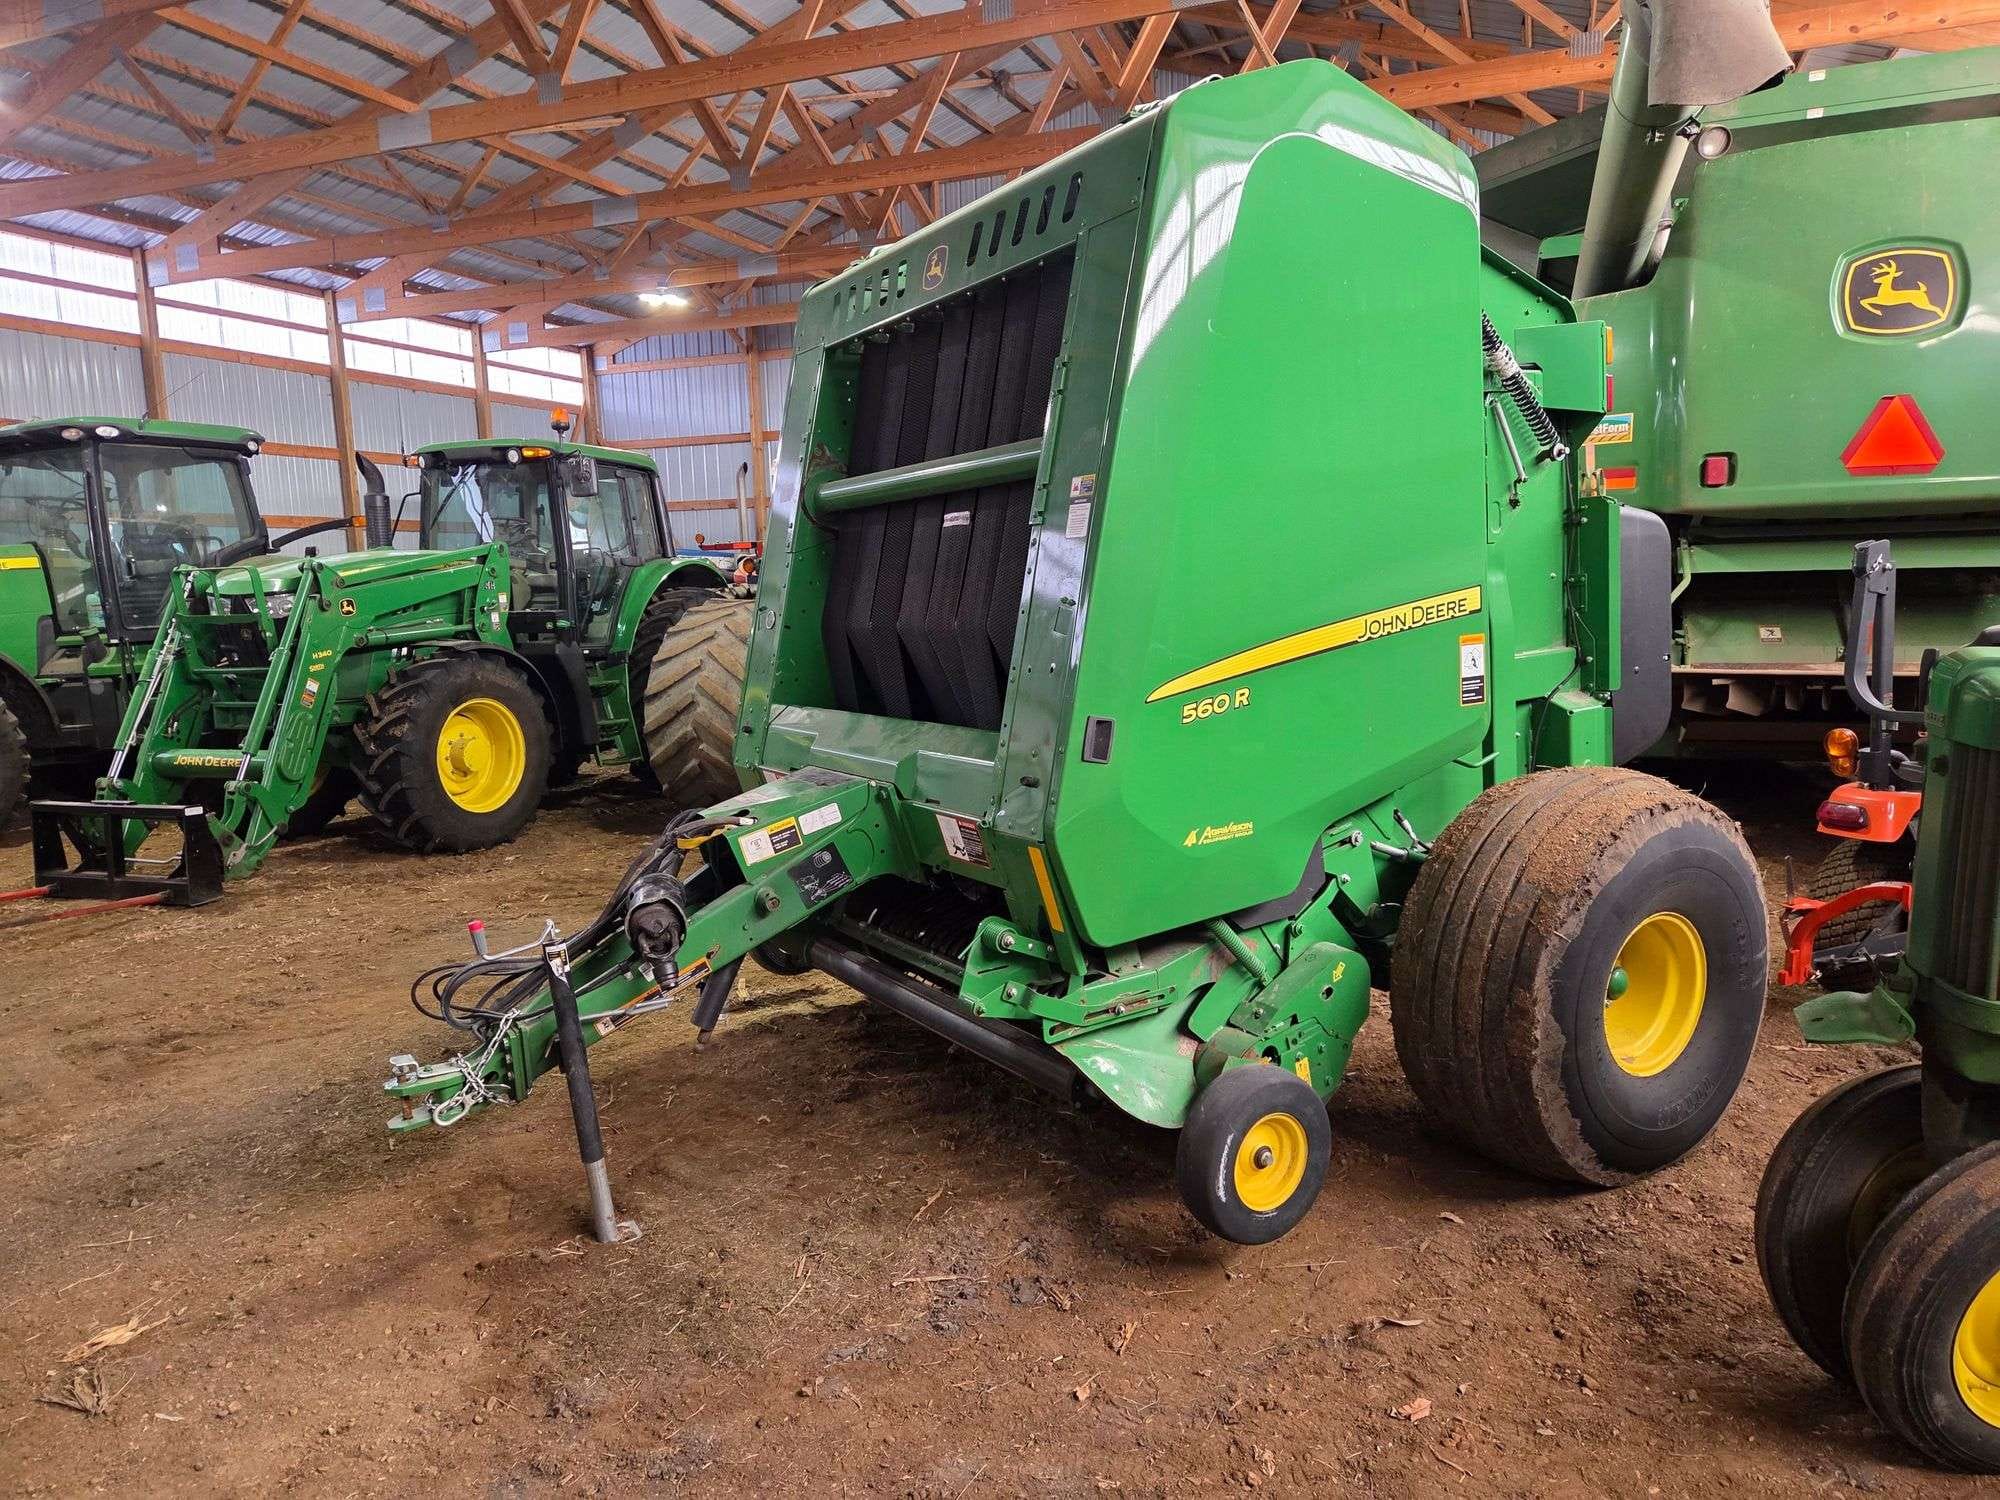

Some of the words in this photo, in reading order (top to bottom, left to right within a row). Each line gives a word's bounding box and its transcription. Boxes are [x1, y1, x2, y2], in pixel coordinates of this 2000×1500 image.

[1359, 612, 1407, 639] JOHN
[1411, 598, 1467, 625] DEERE
[312, 649, 332, 659] H340
[1182, 693, 1231, 724] 560
[1234, 687, 1250, 709] R
[174, 754, 203, 766] JOHN
[205, 755, 241, 767] DEERE
